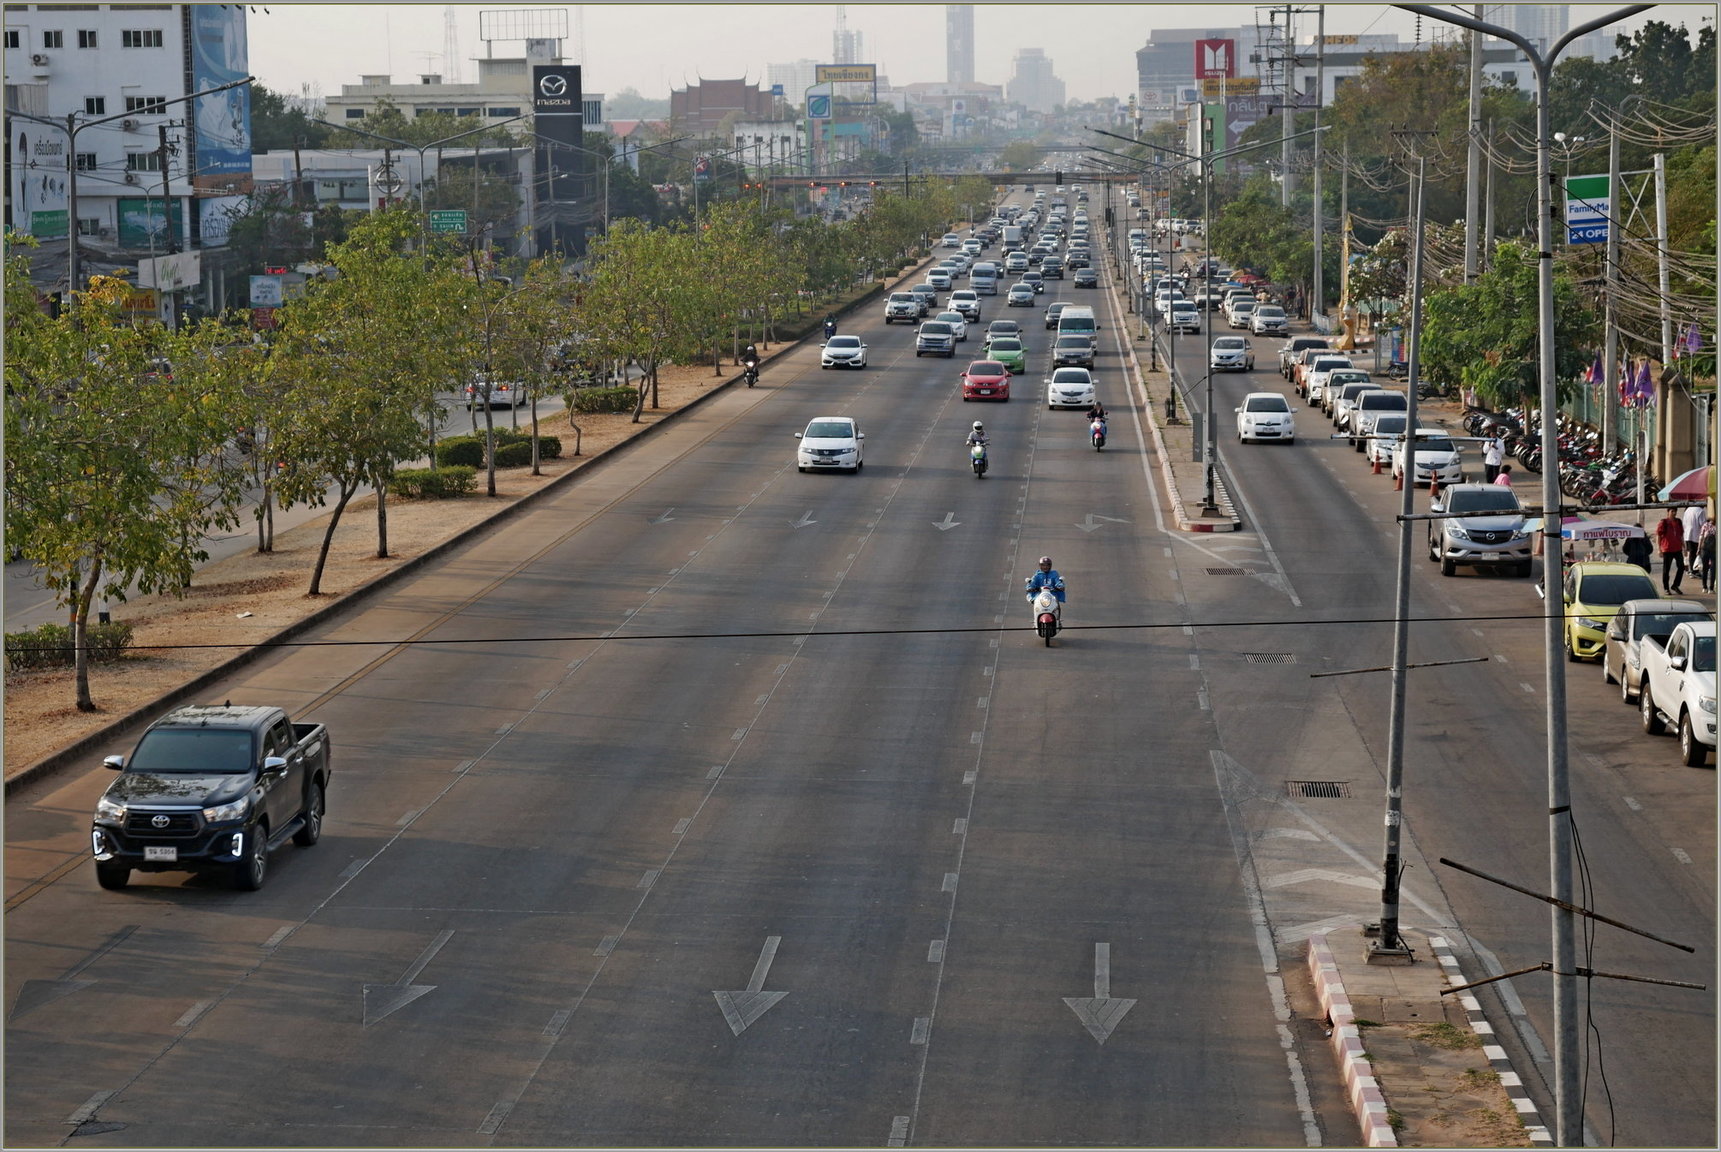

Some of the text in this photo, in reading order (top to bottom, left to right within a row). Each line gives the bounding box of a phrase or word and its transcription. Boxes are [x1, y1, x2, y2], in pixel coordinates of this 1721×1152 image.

[537, 98, 571, 106] mazda
[1569, 203, 1609, 213] FamilyMa
[1586, 229, 1609, 238] OPE
[1583, 529, 1632, 538] กาแฟโบราณ
